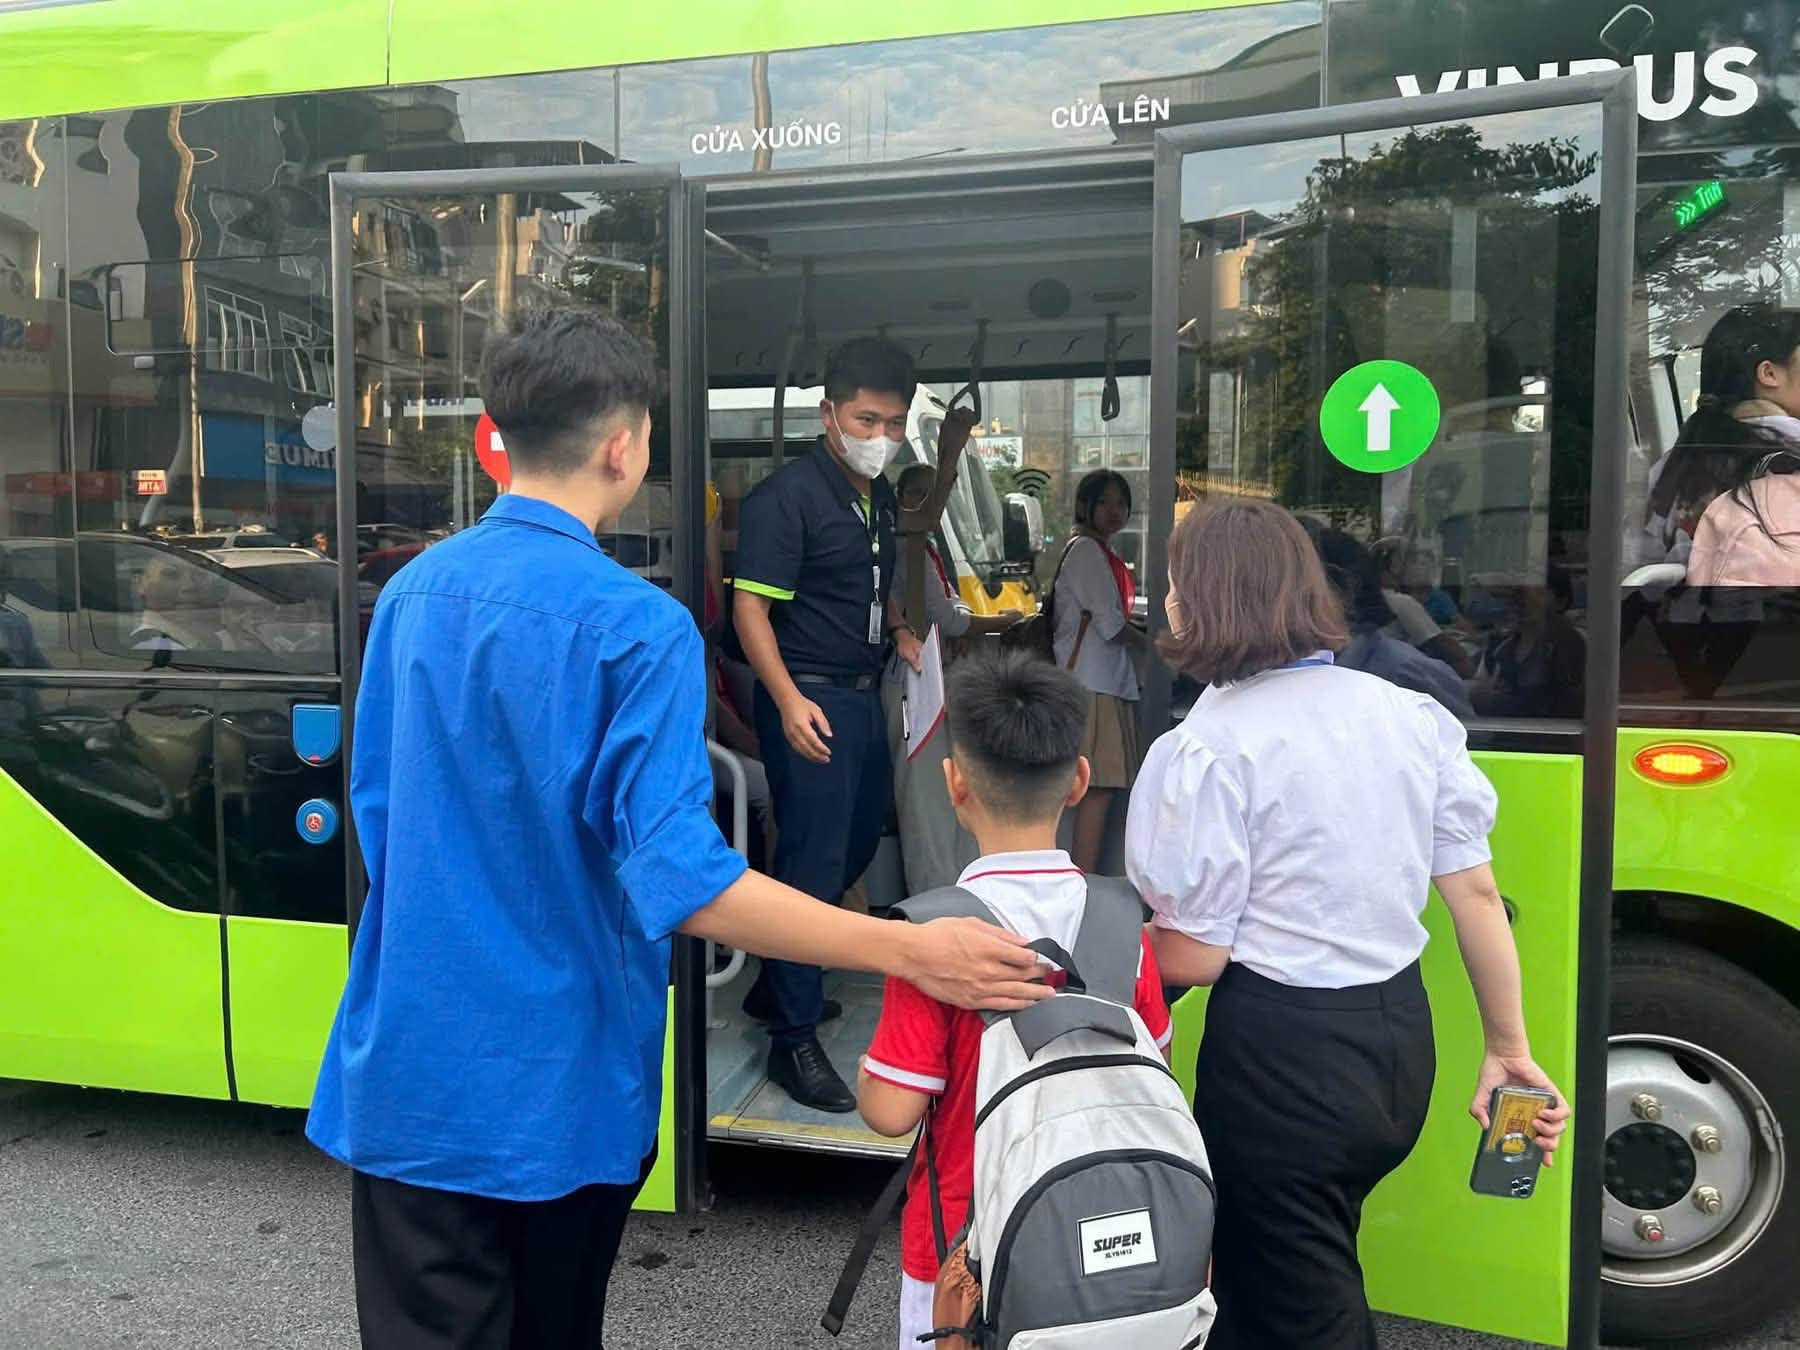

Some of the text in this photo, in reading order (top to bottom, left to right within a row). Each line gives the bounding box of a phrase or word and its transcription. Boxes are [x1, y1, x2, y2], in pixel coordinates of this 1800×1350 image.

[1051, 94, 1170, 128] CỬA LÊN
[691, 117, 841, 154] CỬA XUỐNG
[1093, 1231, 1142, 1253] SUPER
